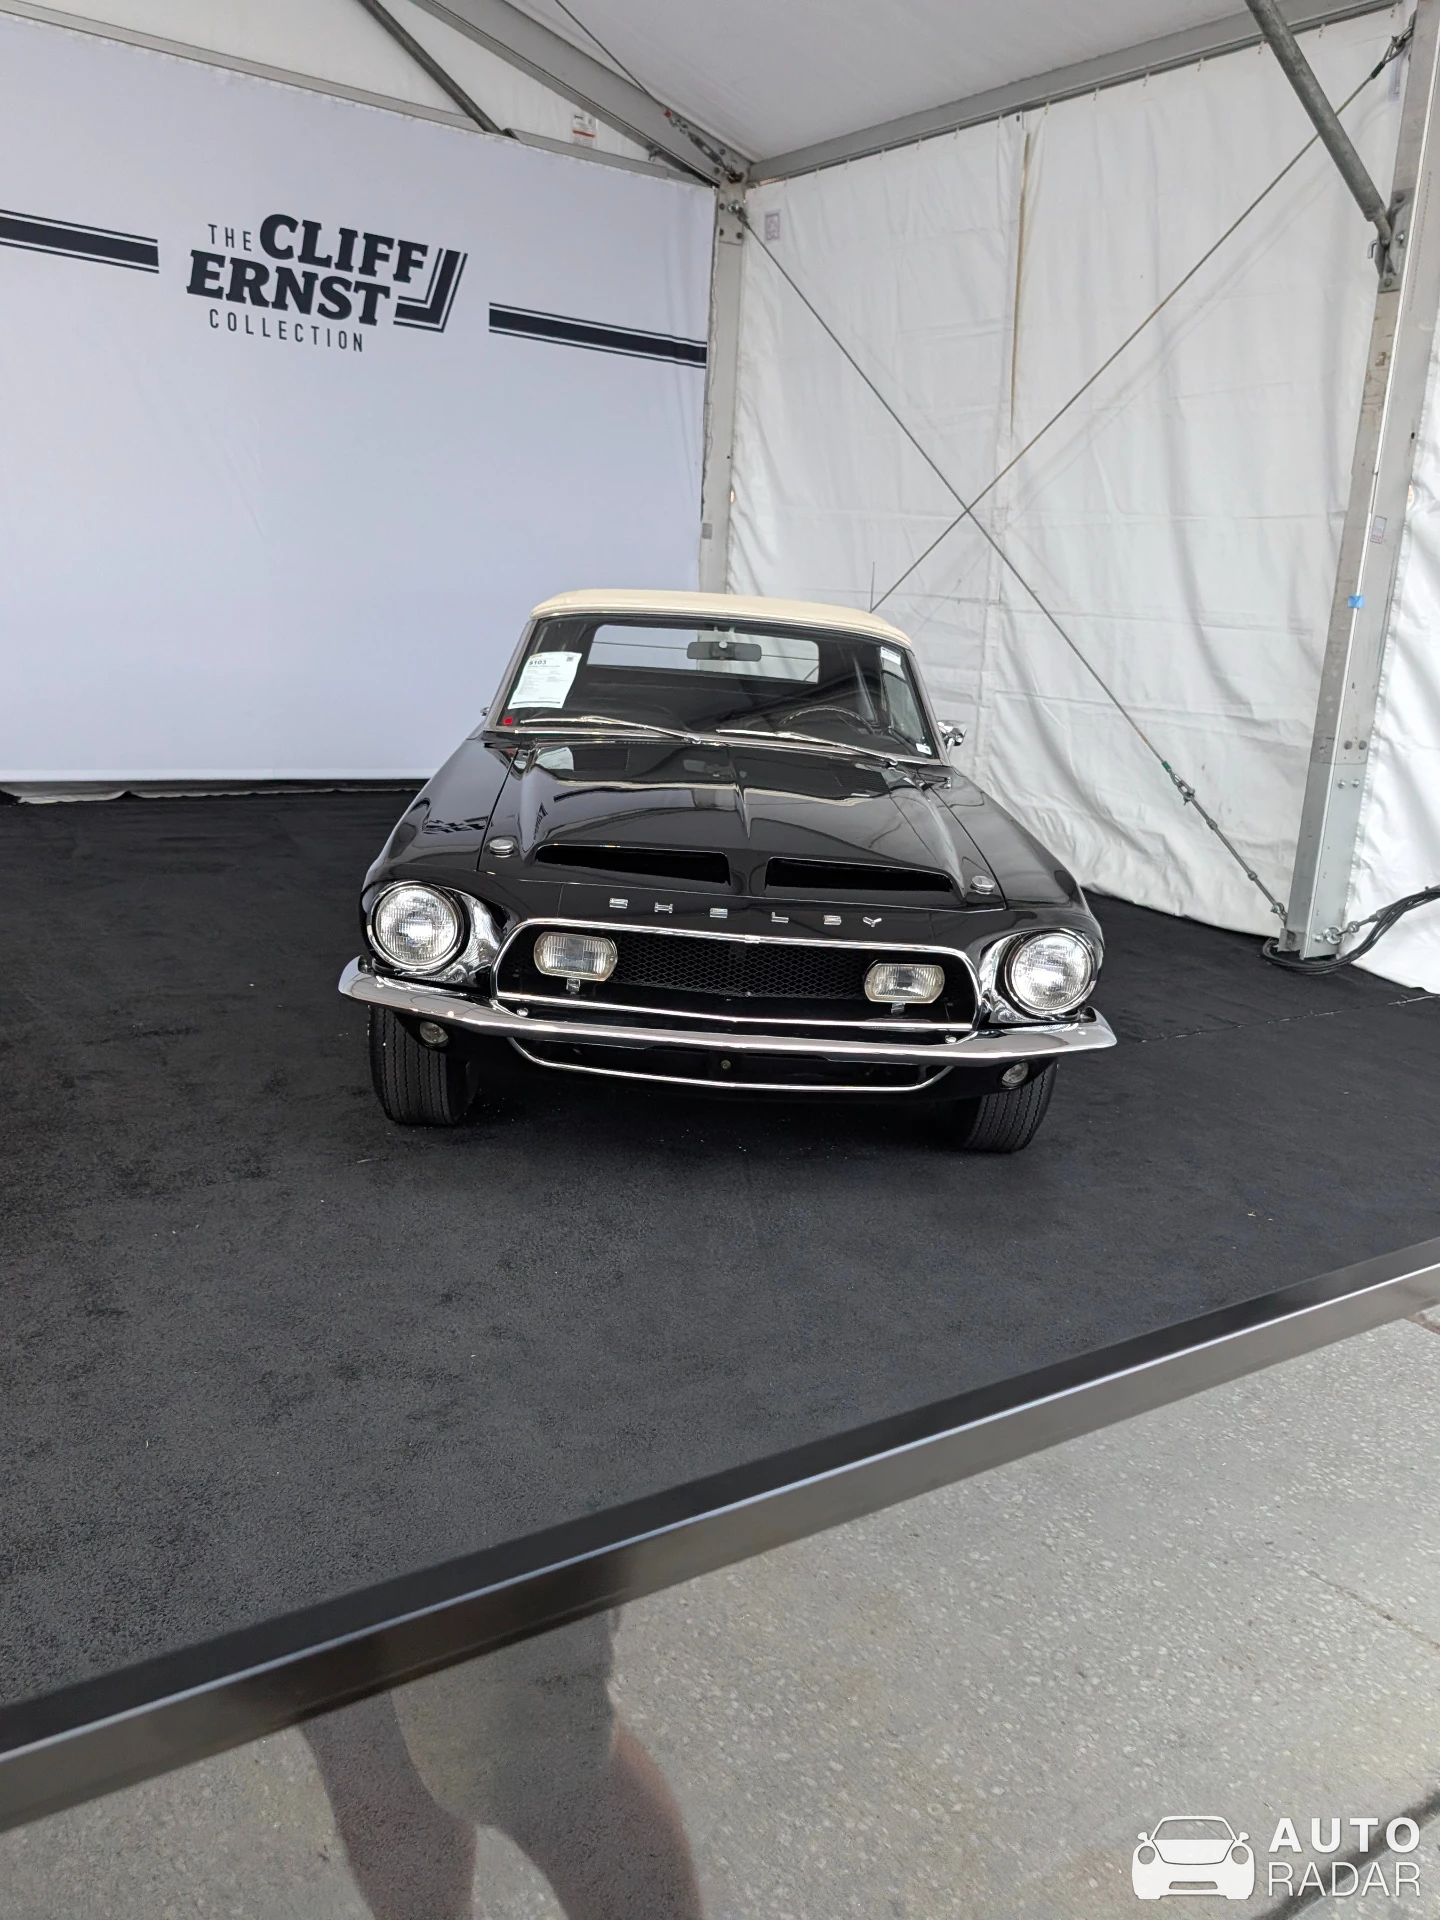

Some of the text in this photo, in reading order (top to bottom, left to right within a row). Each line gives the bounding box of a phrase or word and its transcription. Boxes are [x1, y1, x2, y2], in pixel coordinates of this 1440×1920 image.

[207, 213, 429, 284] THE CLIFF
[186, 249, 391, 326] ERNST
[209, 308, 363, 353] COLLECTION
[609, 897, 882, 927] SHELBY
